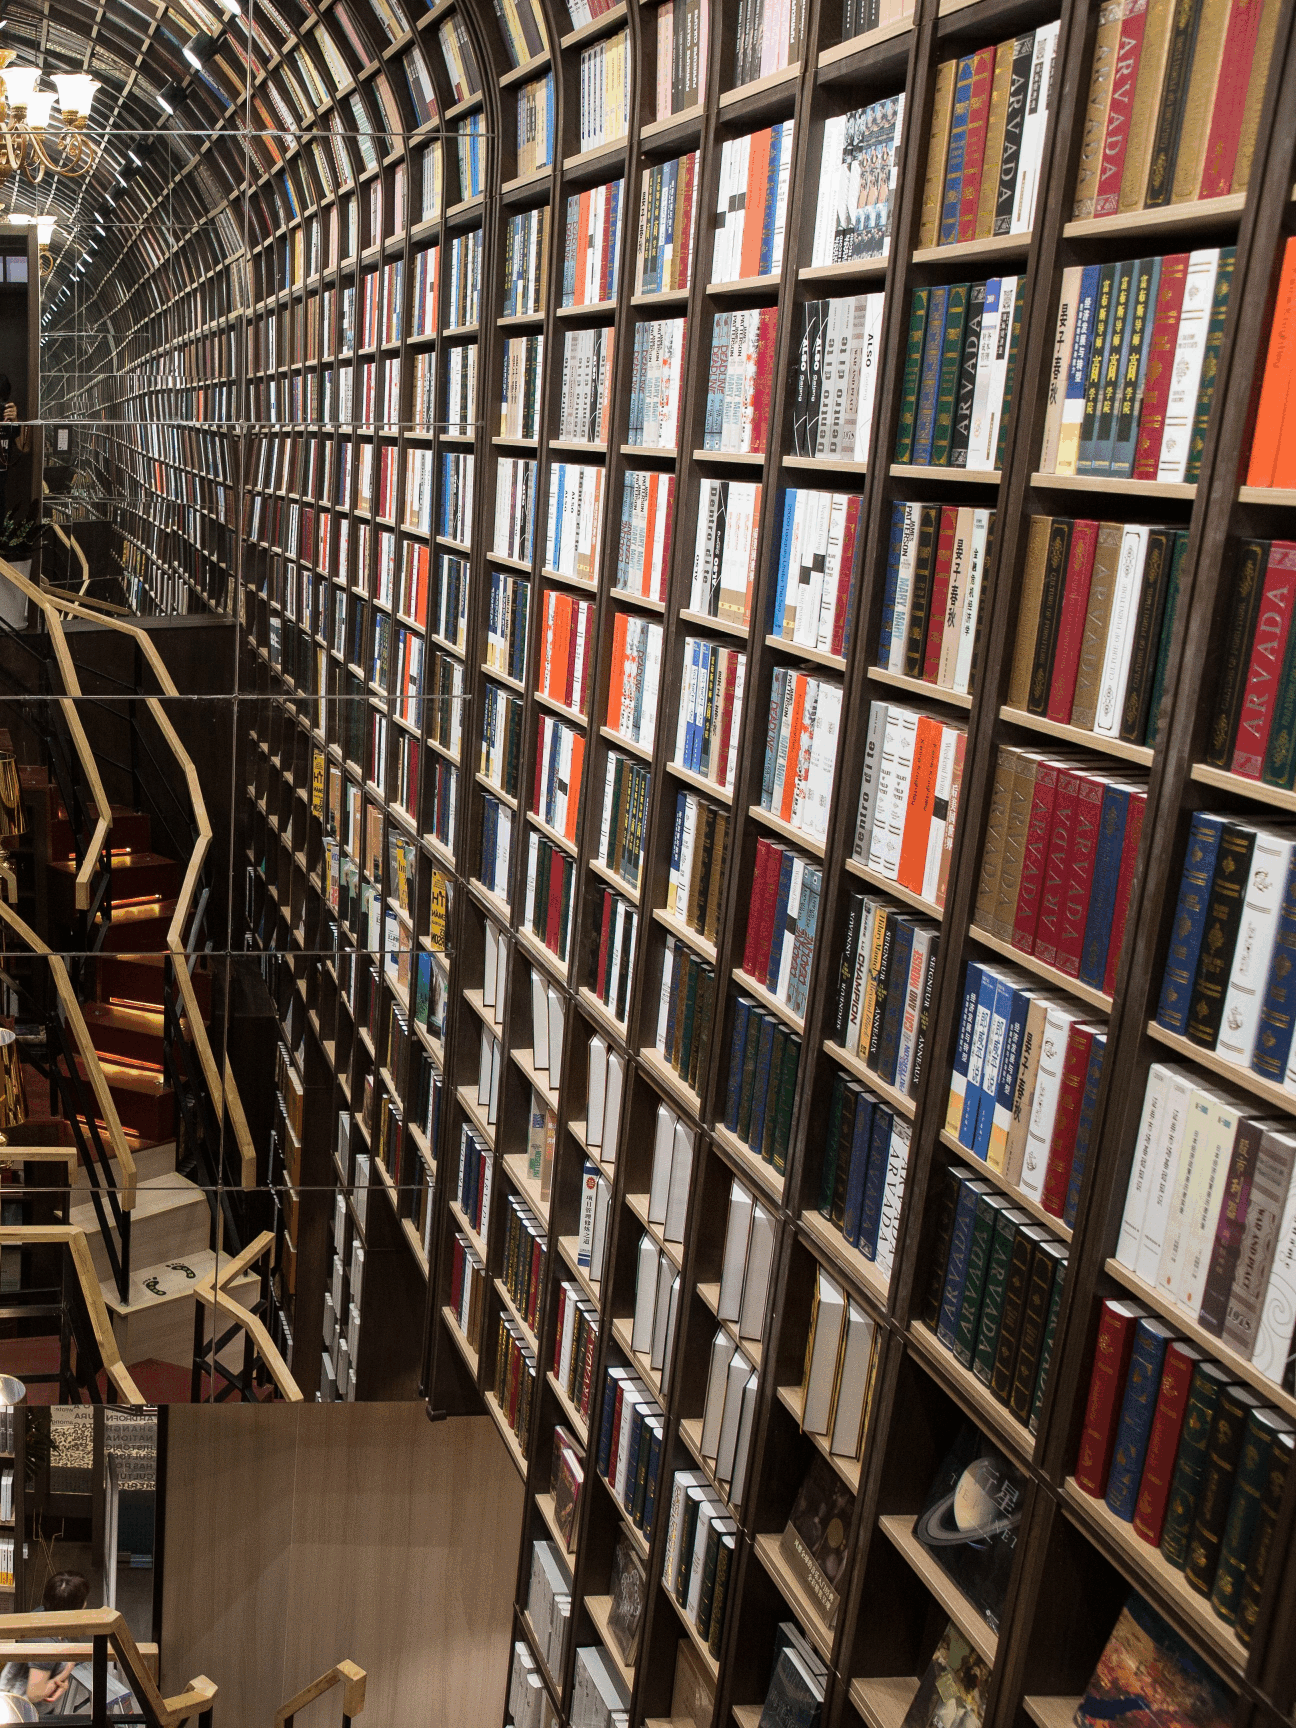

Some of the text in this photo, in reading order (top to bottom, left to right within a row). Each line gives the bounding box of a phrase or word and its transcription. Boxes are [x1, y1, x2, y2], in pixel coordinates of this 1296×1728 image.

[998, 73, 1024, 203] ARVADA
[1080, 46, 1110, 184] ARVADA
[1100, 35, 1137, 182] ARVADA
[709, 345, 720, 395] DEADLINE
[716, 344, 728, 394] DEADLINE
[813, 334, 821, 371] ALSO
[866, 333, 874, 368] ALSO
[956, 312, 982, 435] ARVADA
[817, 338, 835, 453] Dentro di te
[830, 336, 848, 453] Dentro di te
[706, 487, 718, 542] Dentro
[902, 505, 913, 558] PATTERSON
[893, 578, 909, 640] MARY MARY
[1079, 563, 1110, 691] ARVADA
[1109, 585, 1128, 681] CULTURE OF FURNITURE
[1242, 584, 1290, 738] ARVADA
[767, 700, 779, 753] DEADLINE
[941, 742, 952, 775] Weekend
[855, 740, 876, 856] Dentro di te
[980, 784, 1005, 899] ARVADA
[999, 790, 1025, 908] ARVADA
[1018, 798, 1049, 918] ARVADA
[1043, 805, 1072, 933] ARVADA
[1061, 814, 1095, 943] ARVADA
[871, 914, 886, 973] Hilary Mantel
[879, 930, 891, 980] SEIGNEUR
[923, 955, 936, 1008] SEIGNEUR
[836, 983, 846, 1030] SEIGNEUR
[850, 952, 866, 1025] CHAMPION
[871, 1006, 881, 1053] ANNEAUX
[904, 948, 924, 1033] CAT AND MOUSE
[899, 1045, 910, 1093] PATTERSON
[912, 1035, 925, 1084] ANNEAUX
[583, 1194, 593, 1245] 项目管理修炼之道
[879, 1144, 900, 1242] ARVADA
[944, 1214, 970, 1326] ARVADA
[961, 1231, 989, 1341] ARVADA
[1239, 1206, 1266, 1290] WAR AND PEACE
[981, 1245, 1009, 1352] ARVADA
